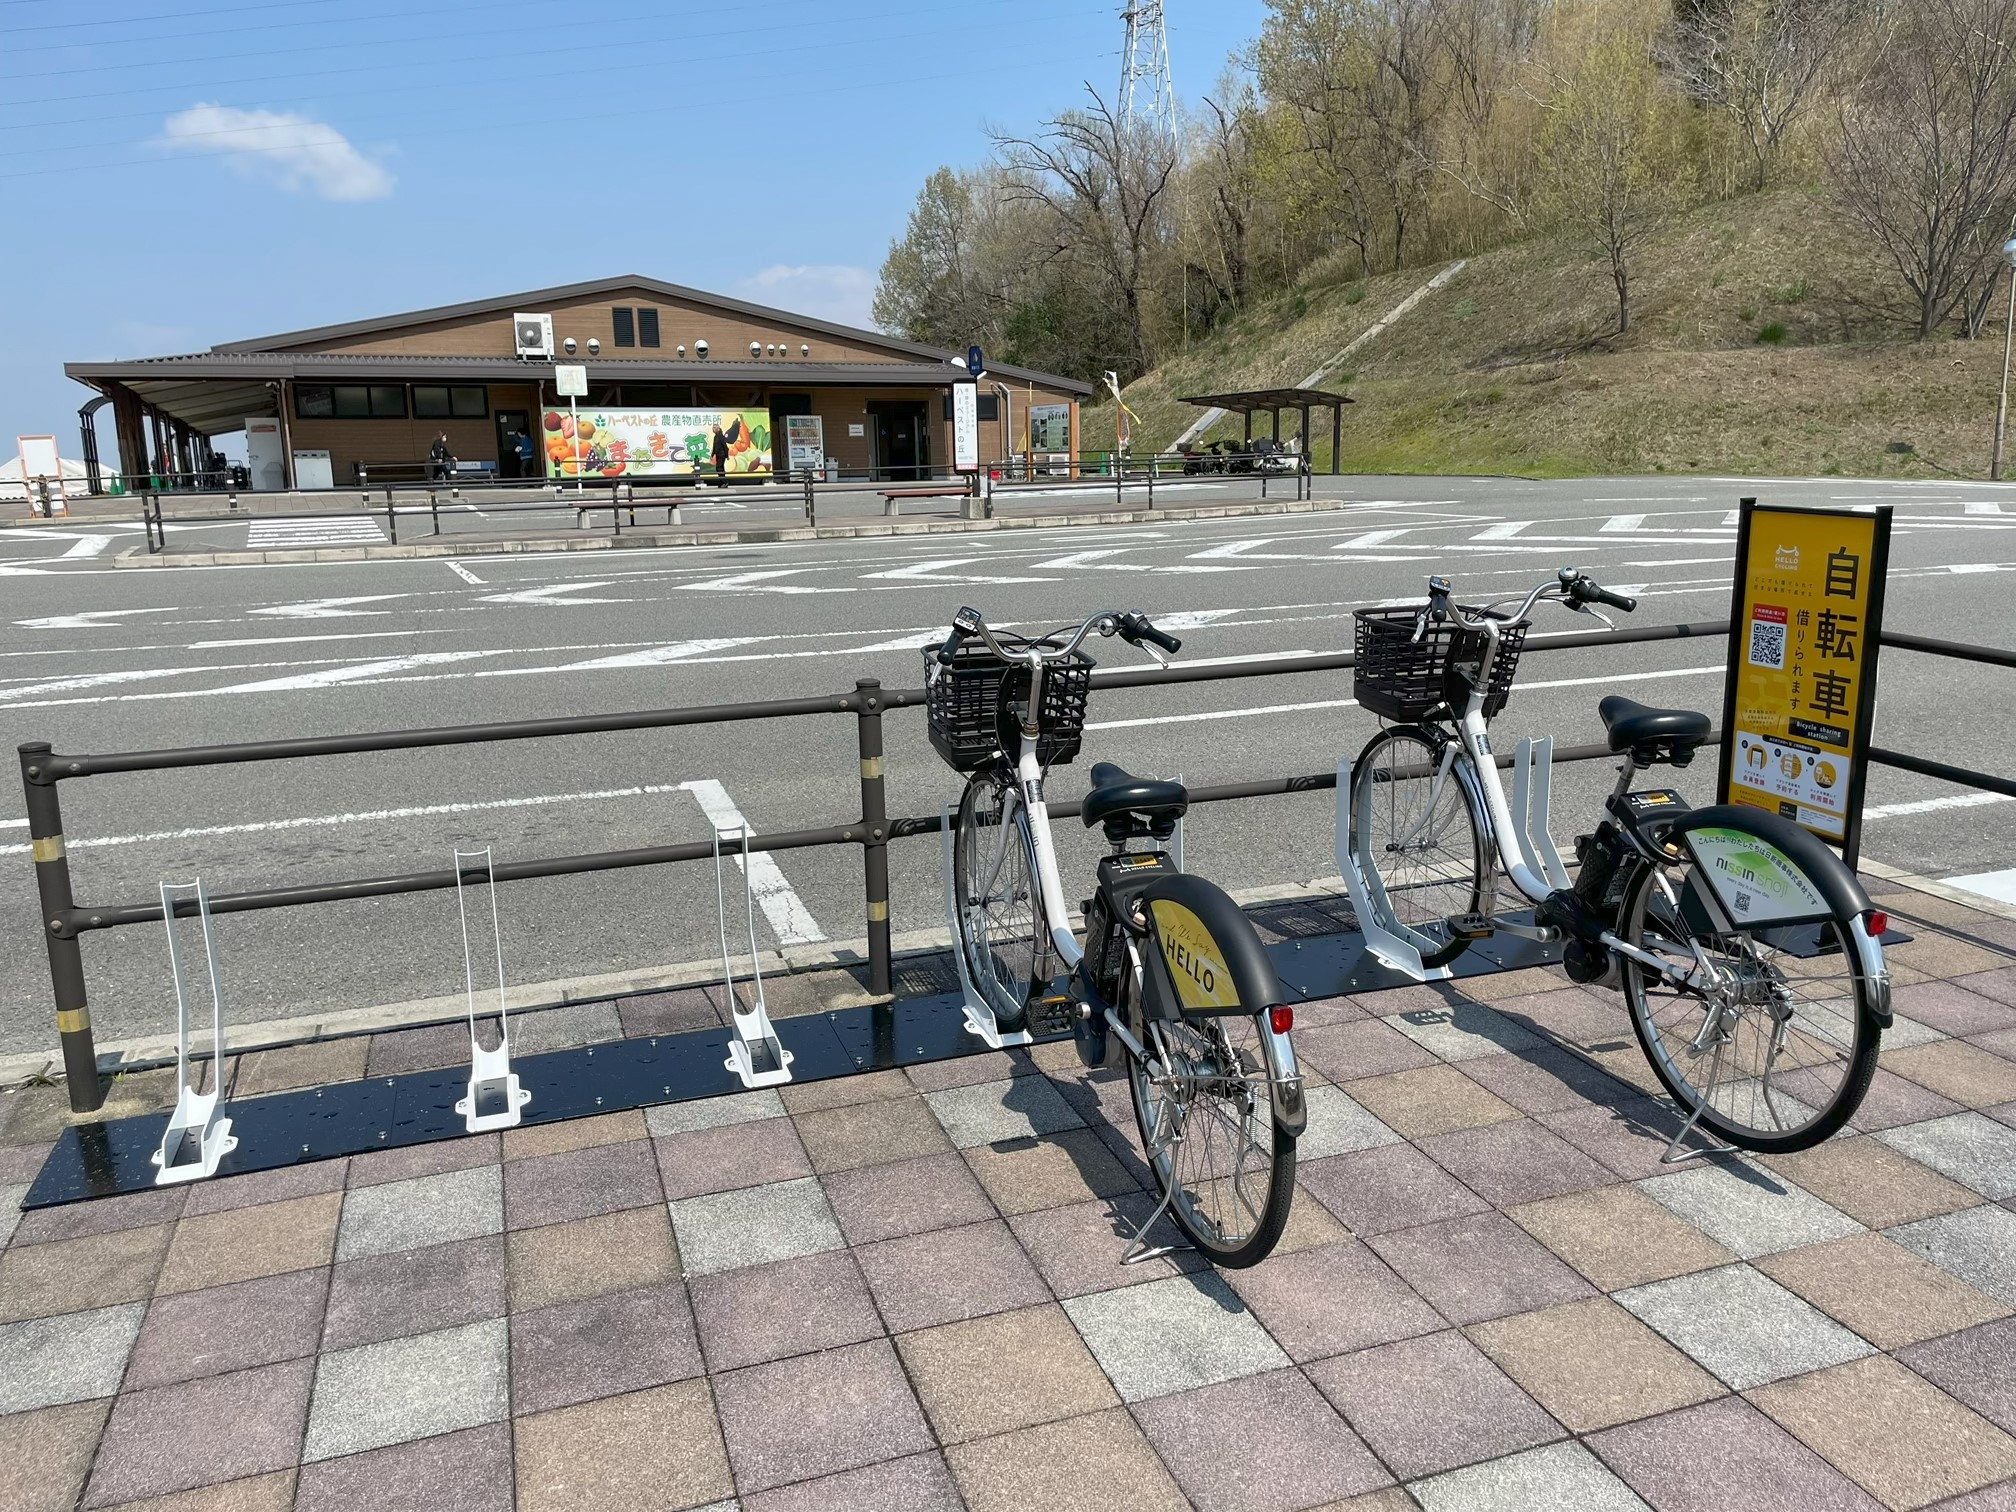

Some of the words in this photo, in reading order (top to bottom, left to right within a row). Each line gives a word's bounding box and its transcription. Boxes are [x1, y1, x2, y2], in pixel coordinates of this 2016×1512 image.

[607, 415, 658, 427] ハーベストの丘
[661, 414, 722, 426] 農産物直売所
[956, 388, 965, 453] ハーベストの丘
[1808, 546, 1860, 719] 自転車
[1788, 608, 1811, 712] 借りられます
[1796, 720, 1817, 732] Bicycle
[1819, 726, 1842, 737] sharing
[1807, 731, 1829, 740] station
[1775, 784, 1799, 796] 予約する
[1809, 793, 1836, 806] 利用開始
[1698, 836, 1726, 845] こんにちは
[1716, 857, 1755, 882] nissin
[1756, 873, 1788, 898] shoji
[1165, 934, 1215, 993] HELLO
